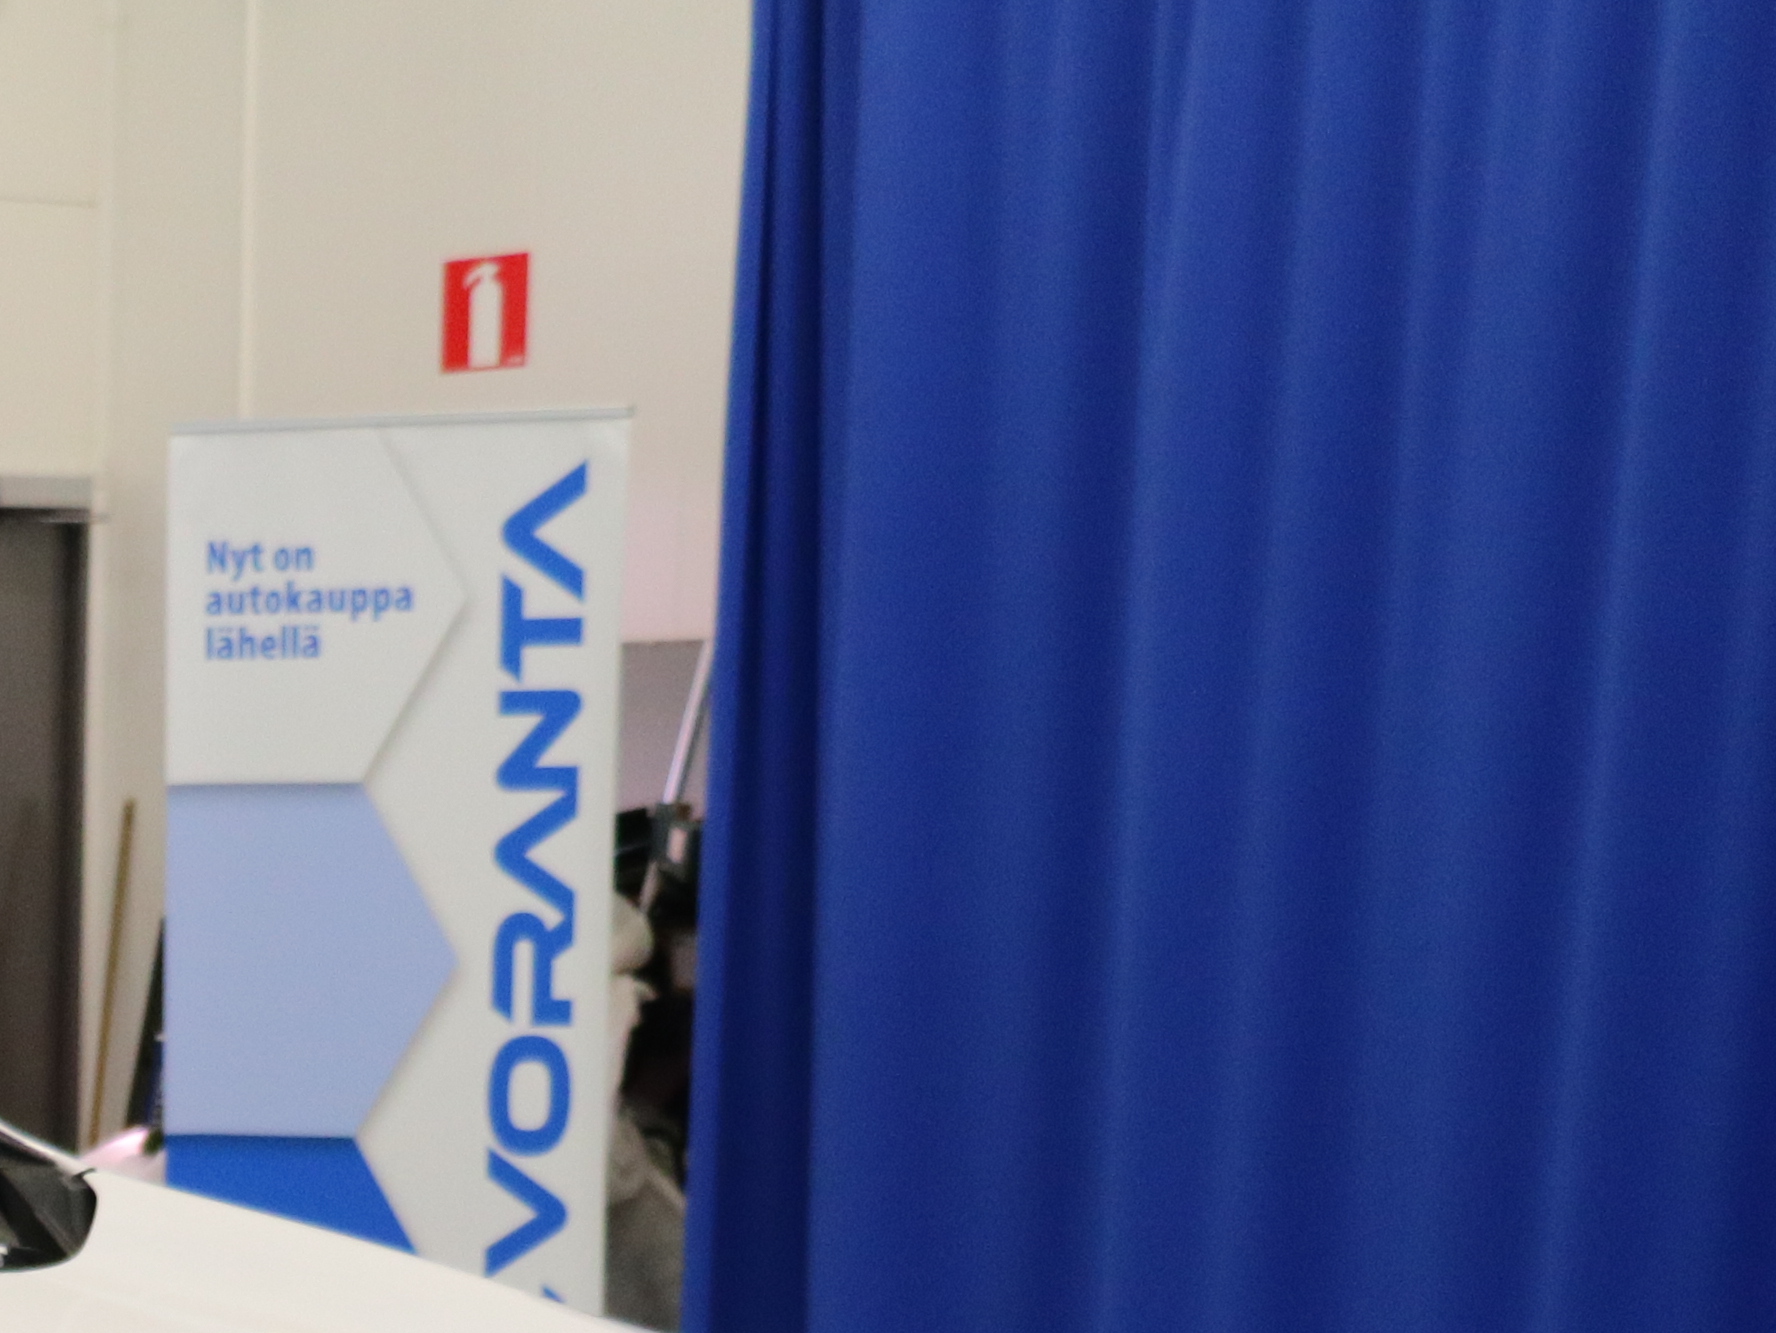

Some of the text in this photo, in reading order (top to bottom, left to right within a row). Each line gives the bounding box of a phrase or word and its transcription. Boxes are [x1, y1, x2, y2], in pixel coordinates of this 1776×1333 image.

[206, 541, 316, 581] Nyt on
[205, 581, 415, 622] autokauppa
[205, 624, 322, 661] lähellä
[485, 459, 590, 1279] VORANTA
